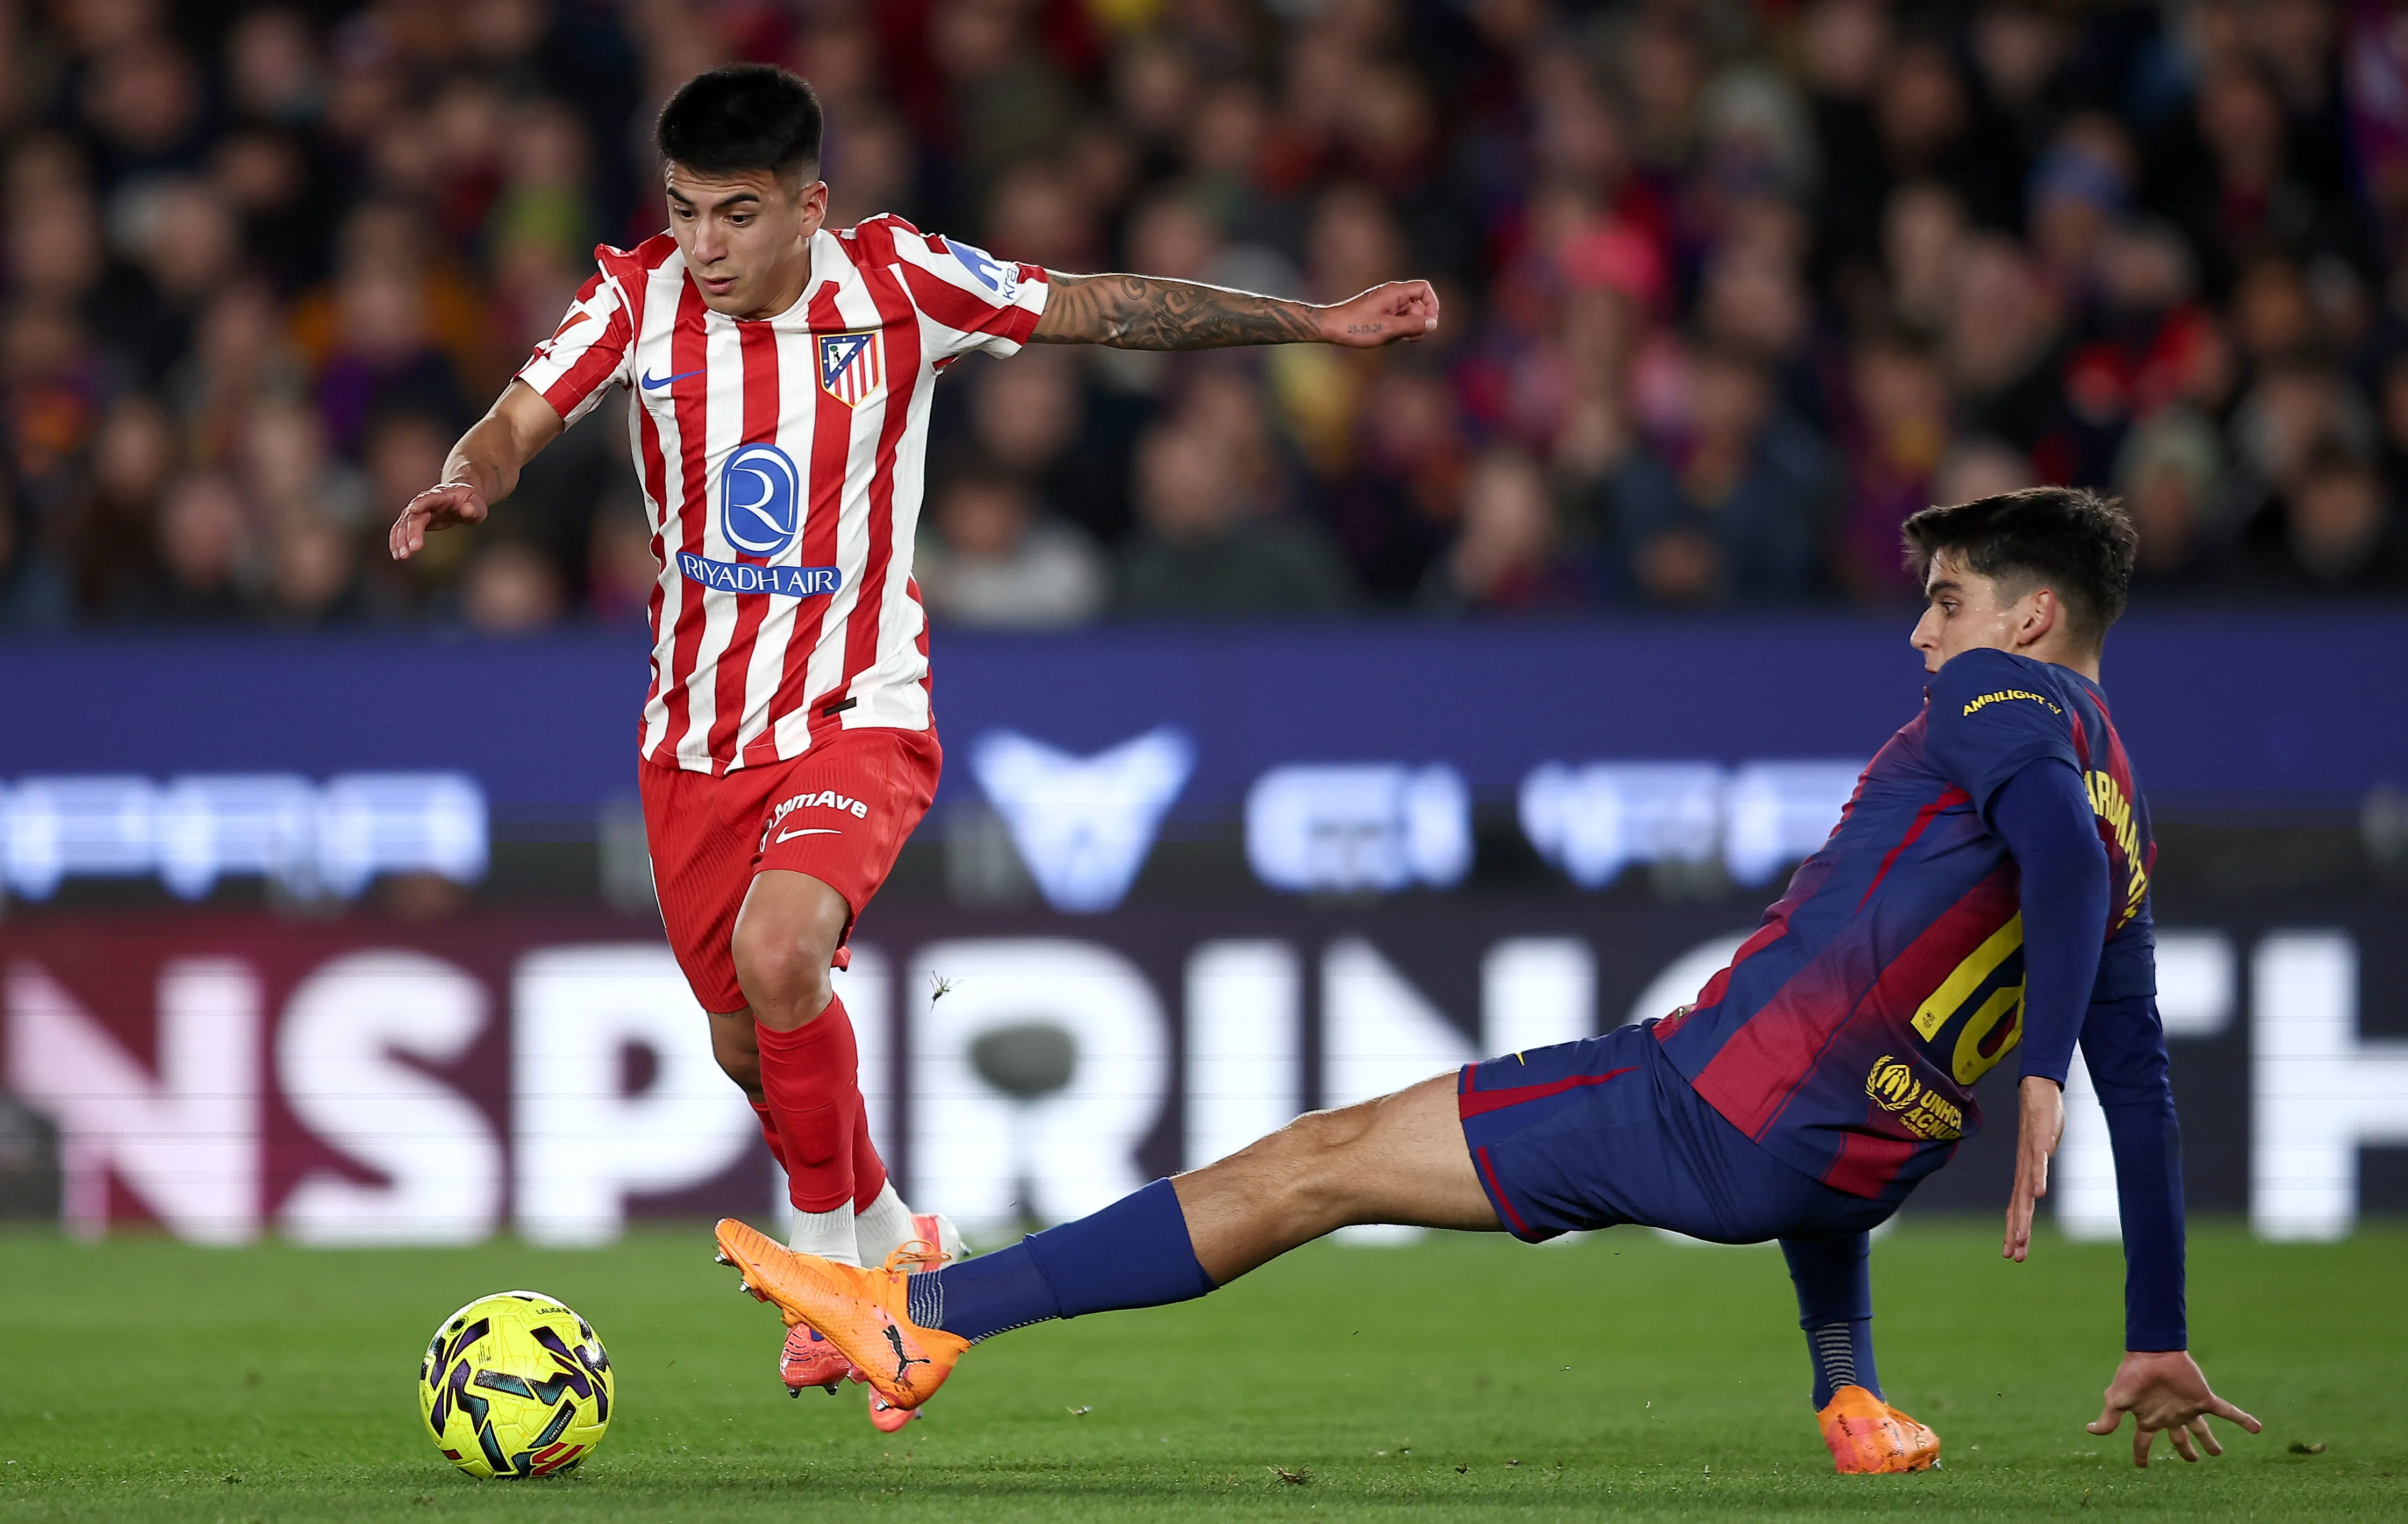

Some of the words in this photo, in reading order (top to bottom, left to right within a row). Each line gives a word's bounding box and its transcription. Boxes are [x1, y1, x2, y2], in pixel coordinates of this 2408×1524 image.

[1003, 268, 1017, 299] kra
[682, 554, 779, 590] RIYADH
[787, 570, 835, 594] AIR
[1963, 689, 2045, 716] AMBILIGHT
